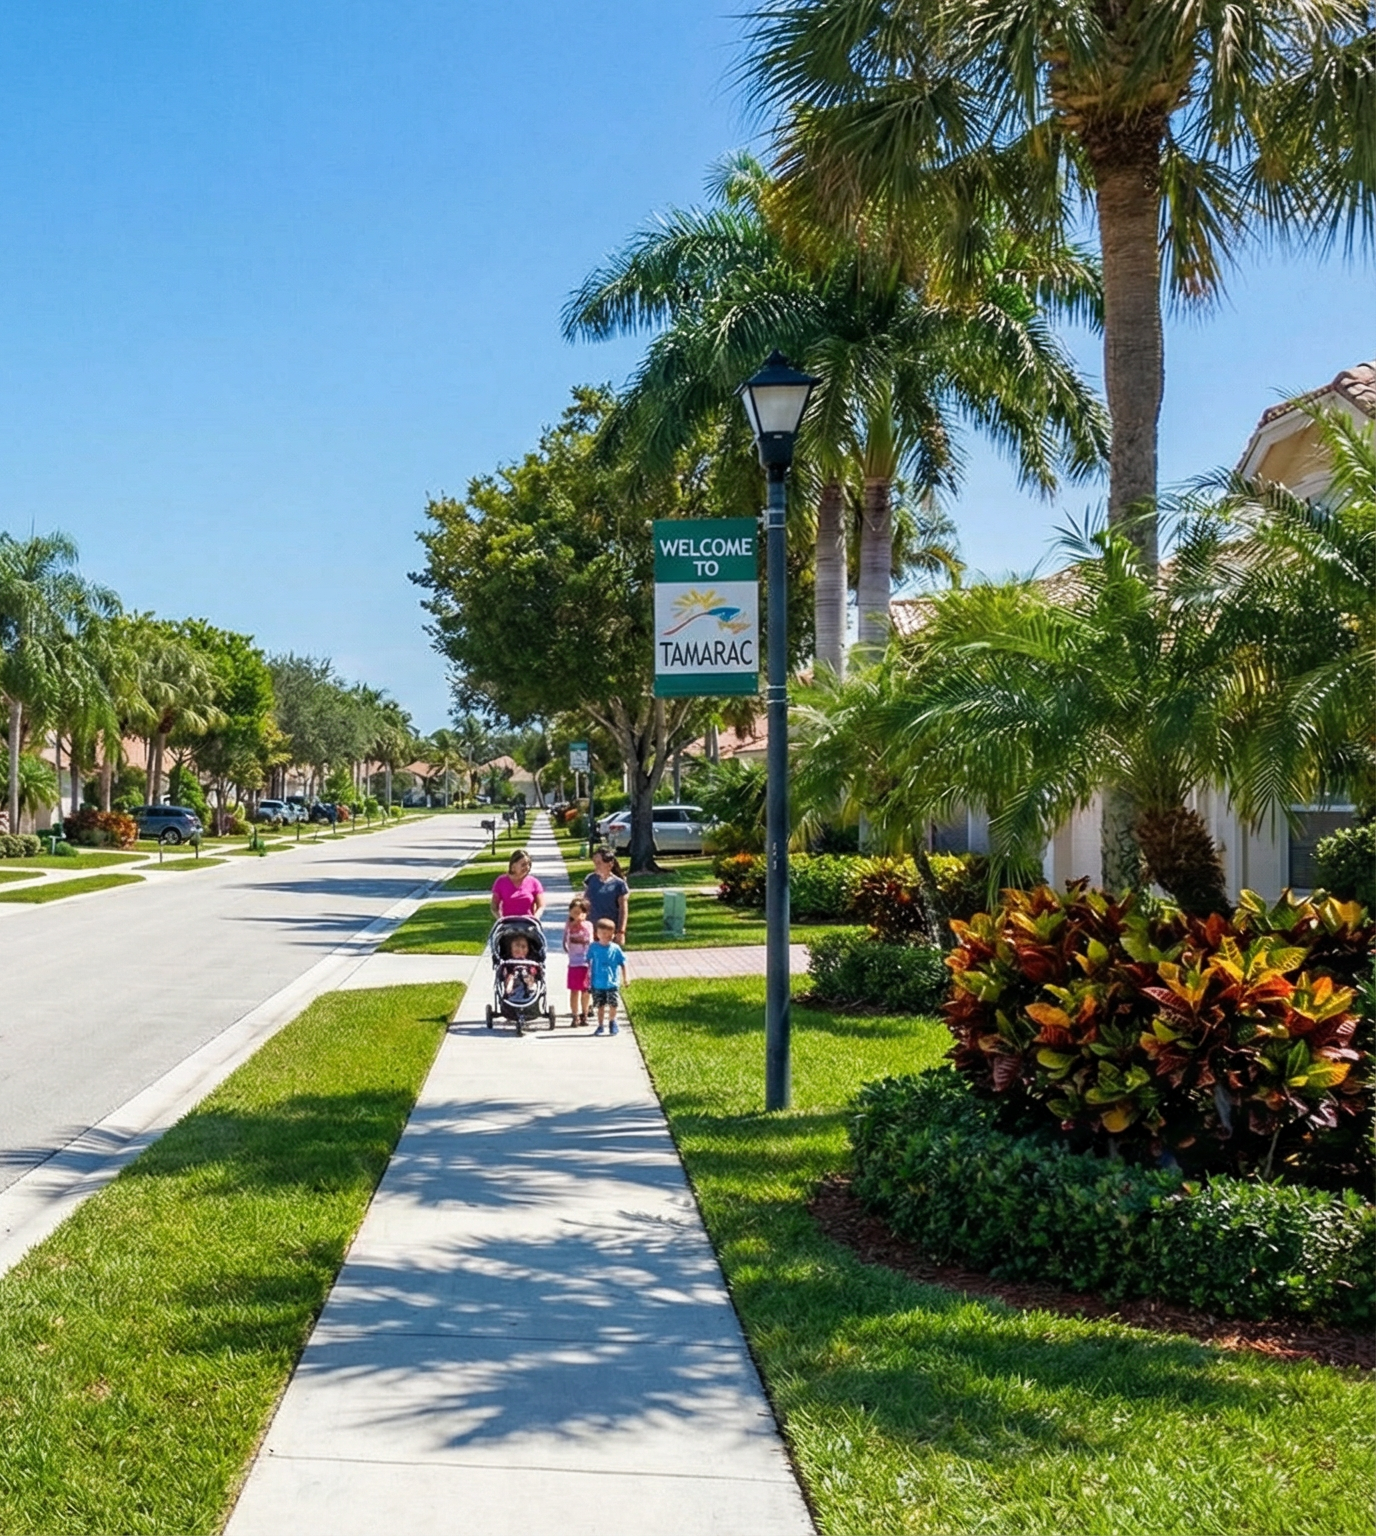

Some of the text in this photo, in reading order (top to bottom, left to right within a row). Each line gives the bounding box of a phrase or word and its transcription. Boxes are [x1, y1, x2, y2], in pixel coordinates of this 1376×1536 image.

[659, 538, 753, 557] WELCOME
[692, 560, 720, 577] TO
[659, 640, 753, 667] TAMARAC
